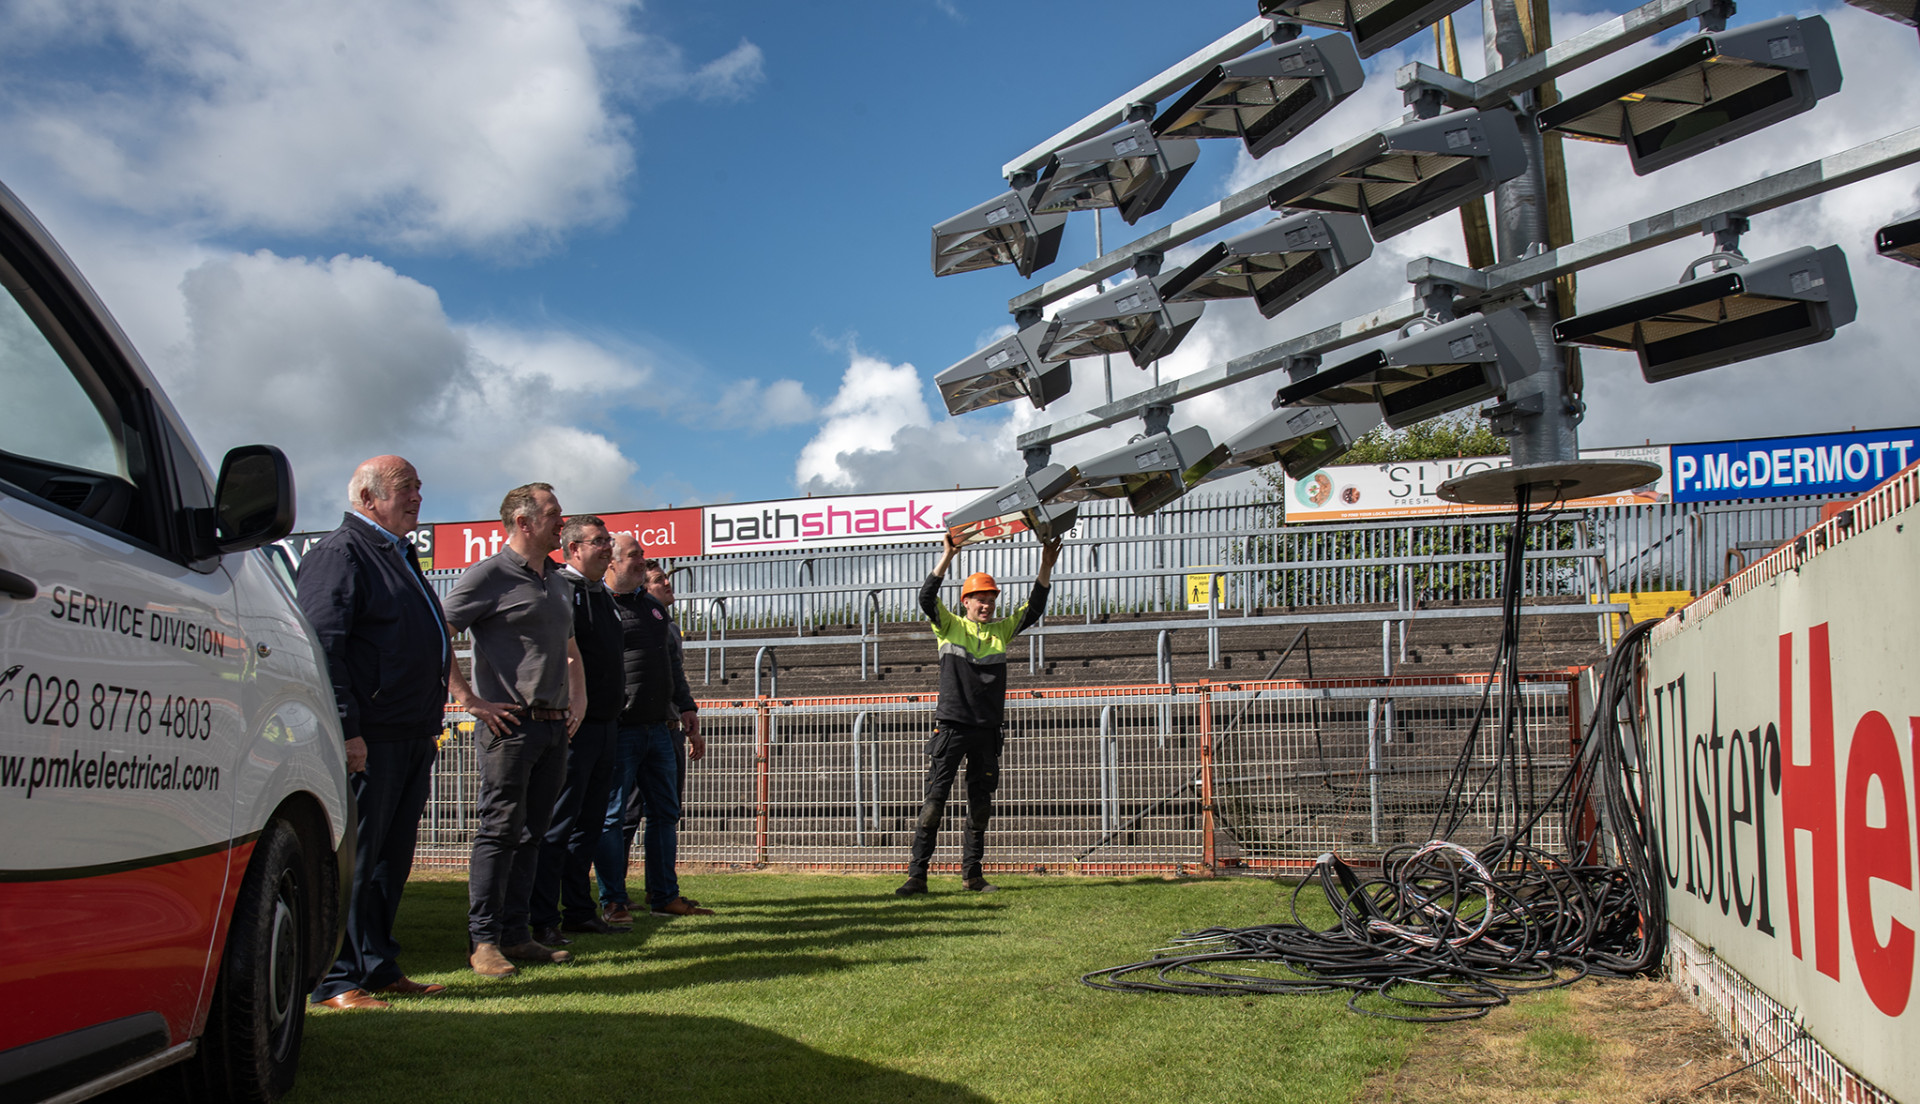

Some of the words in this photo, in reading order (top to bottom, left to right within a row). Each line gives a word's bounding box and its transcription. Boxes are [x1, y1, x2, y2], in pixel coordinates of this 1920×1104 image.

[1615, 448, 1660, 457] FUELLING
[1676, 440, 1914, 492] P.McDERMOTT
[463, 529, 510, 563] ht
[1070, 528, 1077, 538] 6
[51, 586, 144, 638] SERVICE
[150, 613, 225, 658] DIVISION
[24, 673, 79, 728] 028
[90, 683, 152, 735] 8778
[159, 694, 212, 741] 4803
[0, 749, 220, 799] w.pmkelectrical.com
